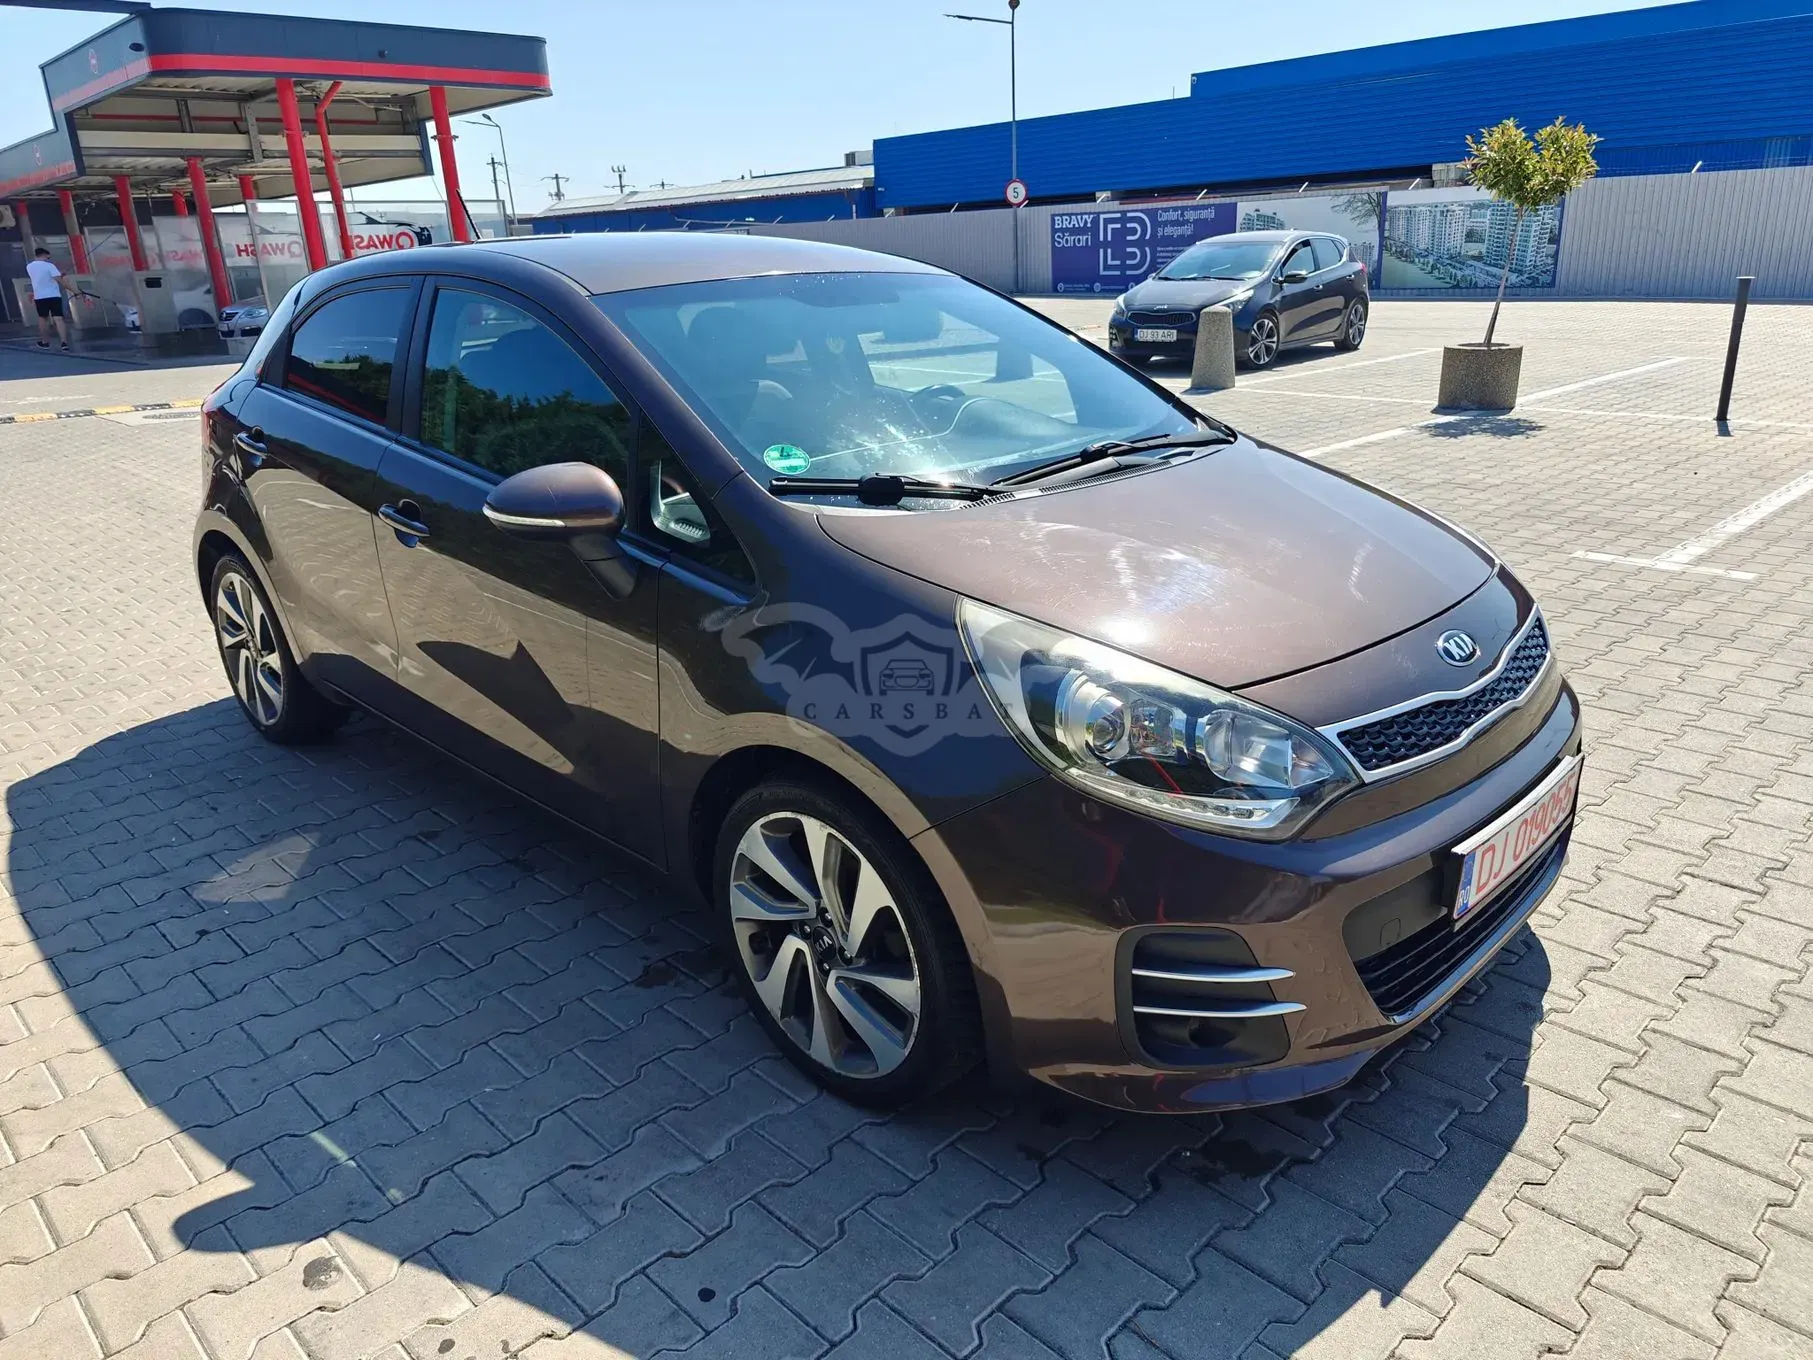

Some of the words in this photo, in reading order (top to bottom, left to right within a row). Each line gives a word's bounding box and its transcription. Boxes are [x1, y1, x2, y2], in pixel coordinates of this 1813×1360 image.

[1012, 187, 1019, 199] 5
[1054, 214, 1094, 229] BRAVY
[1157, 210, 1183, 222] Confort,
[1183, 207, 1215, 222] siguranță
[1157, 226, 1163, 239] și
[1163, 223, 1194, 239] eleganță!
[1054, 232, 1092, 248] Sărari
[1139, 331, 1148, 339] DJ
[1150, 331, 1158, 339] 93
[1443, 633, 1474, 660] KIA
[1476, 831, 1509, 895] DJ
[1513, 772, 1575, 861] 019055
[1457, 886, 1470, 908] RO
[815, 935, 832, 952] KIA
